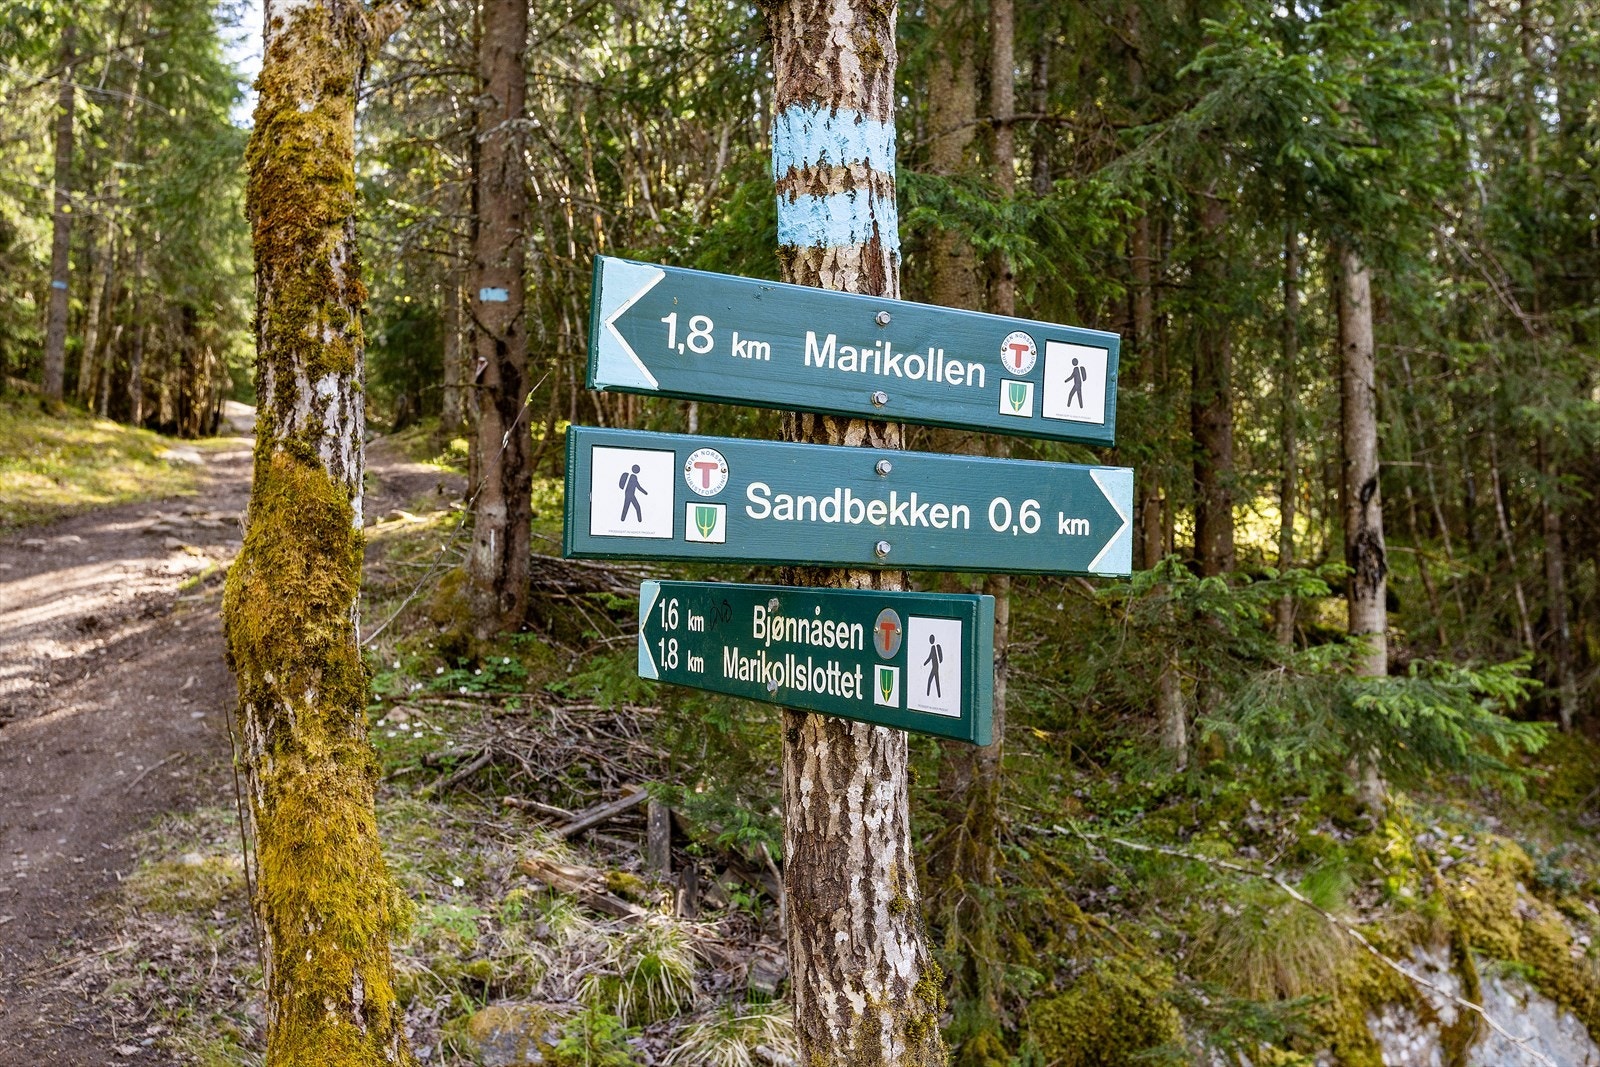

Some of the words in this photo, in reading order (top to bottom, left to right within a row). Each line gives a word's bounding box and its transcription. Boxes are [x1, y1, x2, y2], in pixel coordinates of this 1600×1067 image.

[660, 311, 715, 355] 1,8
[731, 331, 771, 362] km
[804, 330, 986, 388] Marikollen
[1008, 343, 1030, 369] T
[693, 461, 719, 489] T
[700, 450, 726, 468] NORSKE
[745, 481, 971, 530] Sandbekken
[988, 496, 1042, 537] 0,6
[1058, 511, 1090, 536] km
[658, 598, 679, 632] 1,6
[687, 609, 705, 633] km
[753, 605, 864, 651] Bjønnåsen
[880, 622, 896, 651] T
[658, 637, 679, 671] 1,8
[687, 649, 704, 674] km
[723, 645, 863, 700] Marikollslottet
